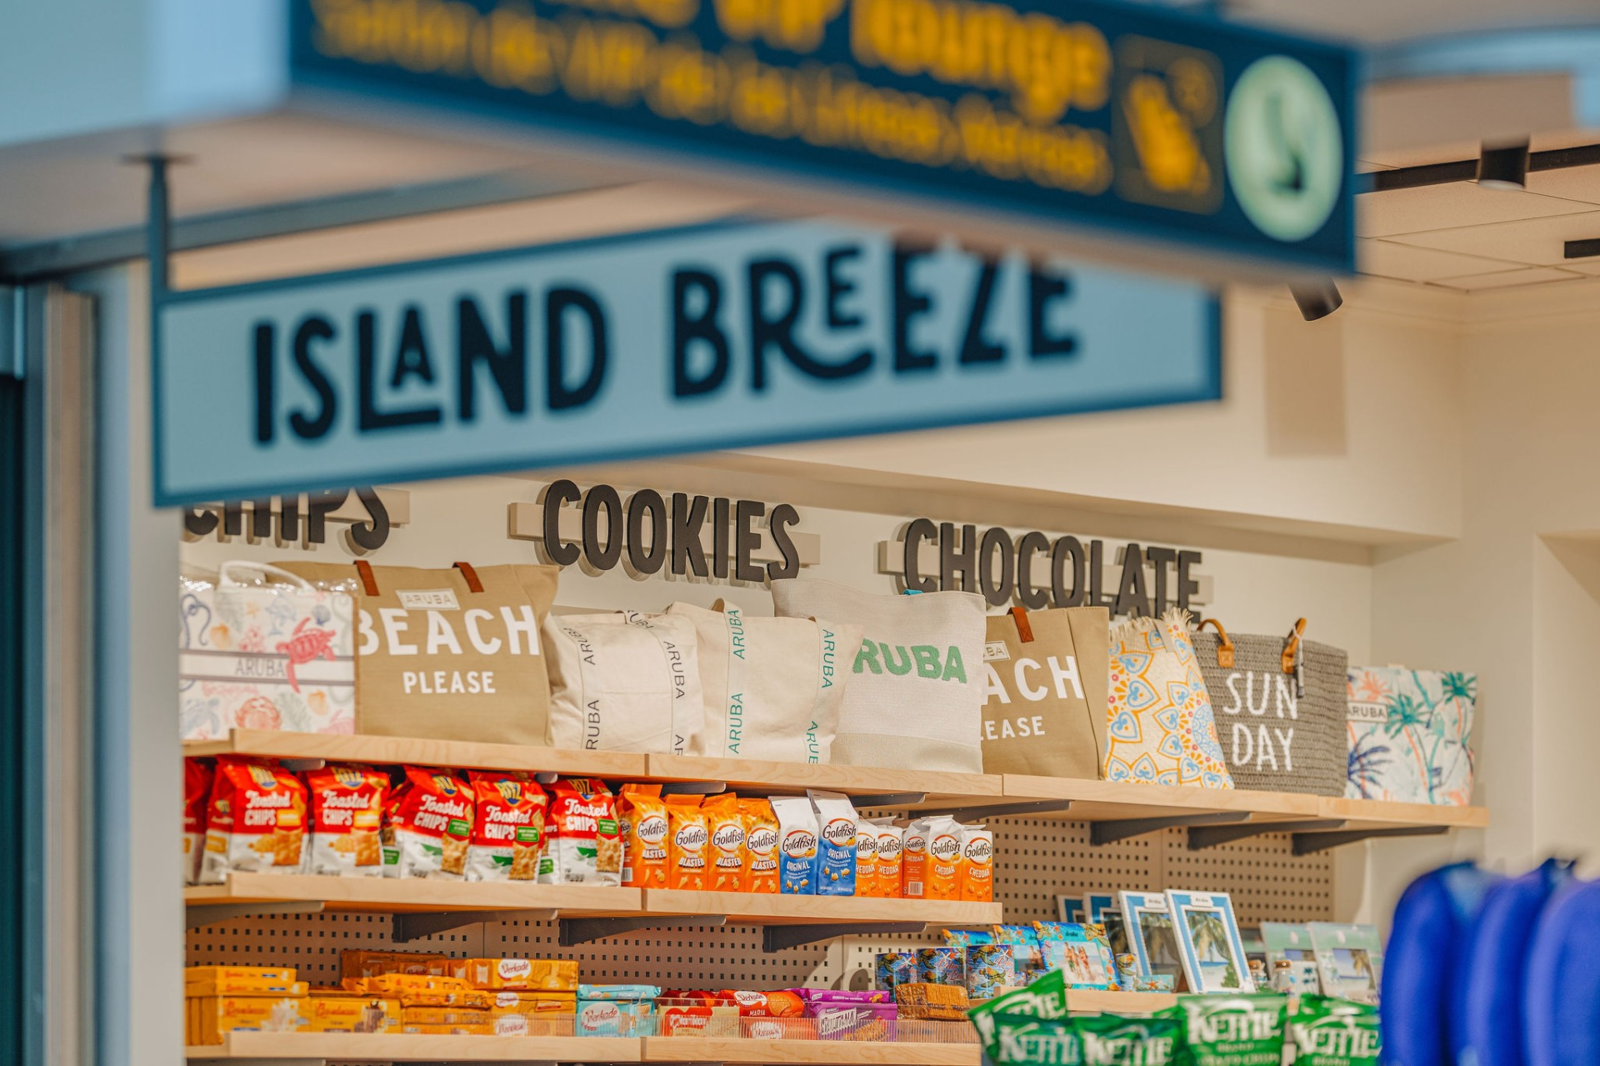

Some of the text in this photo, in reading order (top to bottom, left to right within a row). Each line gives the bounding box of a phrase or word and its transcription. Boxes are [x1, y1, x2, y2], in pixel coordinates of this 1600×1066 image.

[253, 240, 1081, 446] ISLAND BREEZE
[543, 479, 800, 582] COOKIES
[904, 518, 1202, 624] CHOCOLATE
[358, 604, 541, 656] BEACH
[727, 609, 746, 660] ARUBA
[234, 658, 287, 679] ARUBA
[822, 628, 836, 689] ARUBA
[852, 637, 968, 684] RUBA
[663, 640, 686, 700] ARUBA
[403, 671, 496, 694] PLEASE
[1222, 670, 1299, 720] SUN
[585, 700, 601, 751] RUBA
[727, 693, 744, 755] ARUBA
[1231, 724, 1295, 772] DAY
[419, 793, 465, 818] Toasted
[484, 805, 532, 824] Toasted
[564, 797, 609, 818] Toasted
[413, 811, 449, 832] CHIPS
[484, 822, 516, 841] CHIPS
[565, 815, 598, 833] CHIPS
[822, 824, 857, 840] Goldfish
[675, 829, 708, 847] Goldfish
[712, 828, 745, 846] Goldfish
[746, 832, 779, 850] Goldfish
[782, 835, 817, 853] Goldfish
[931, 839, 961, 856] Goldfish
[934, 864, 956, 876] CHEDDAR
[968, 867, 991, 878] CHEDDAR
